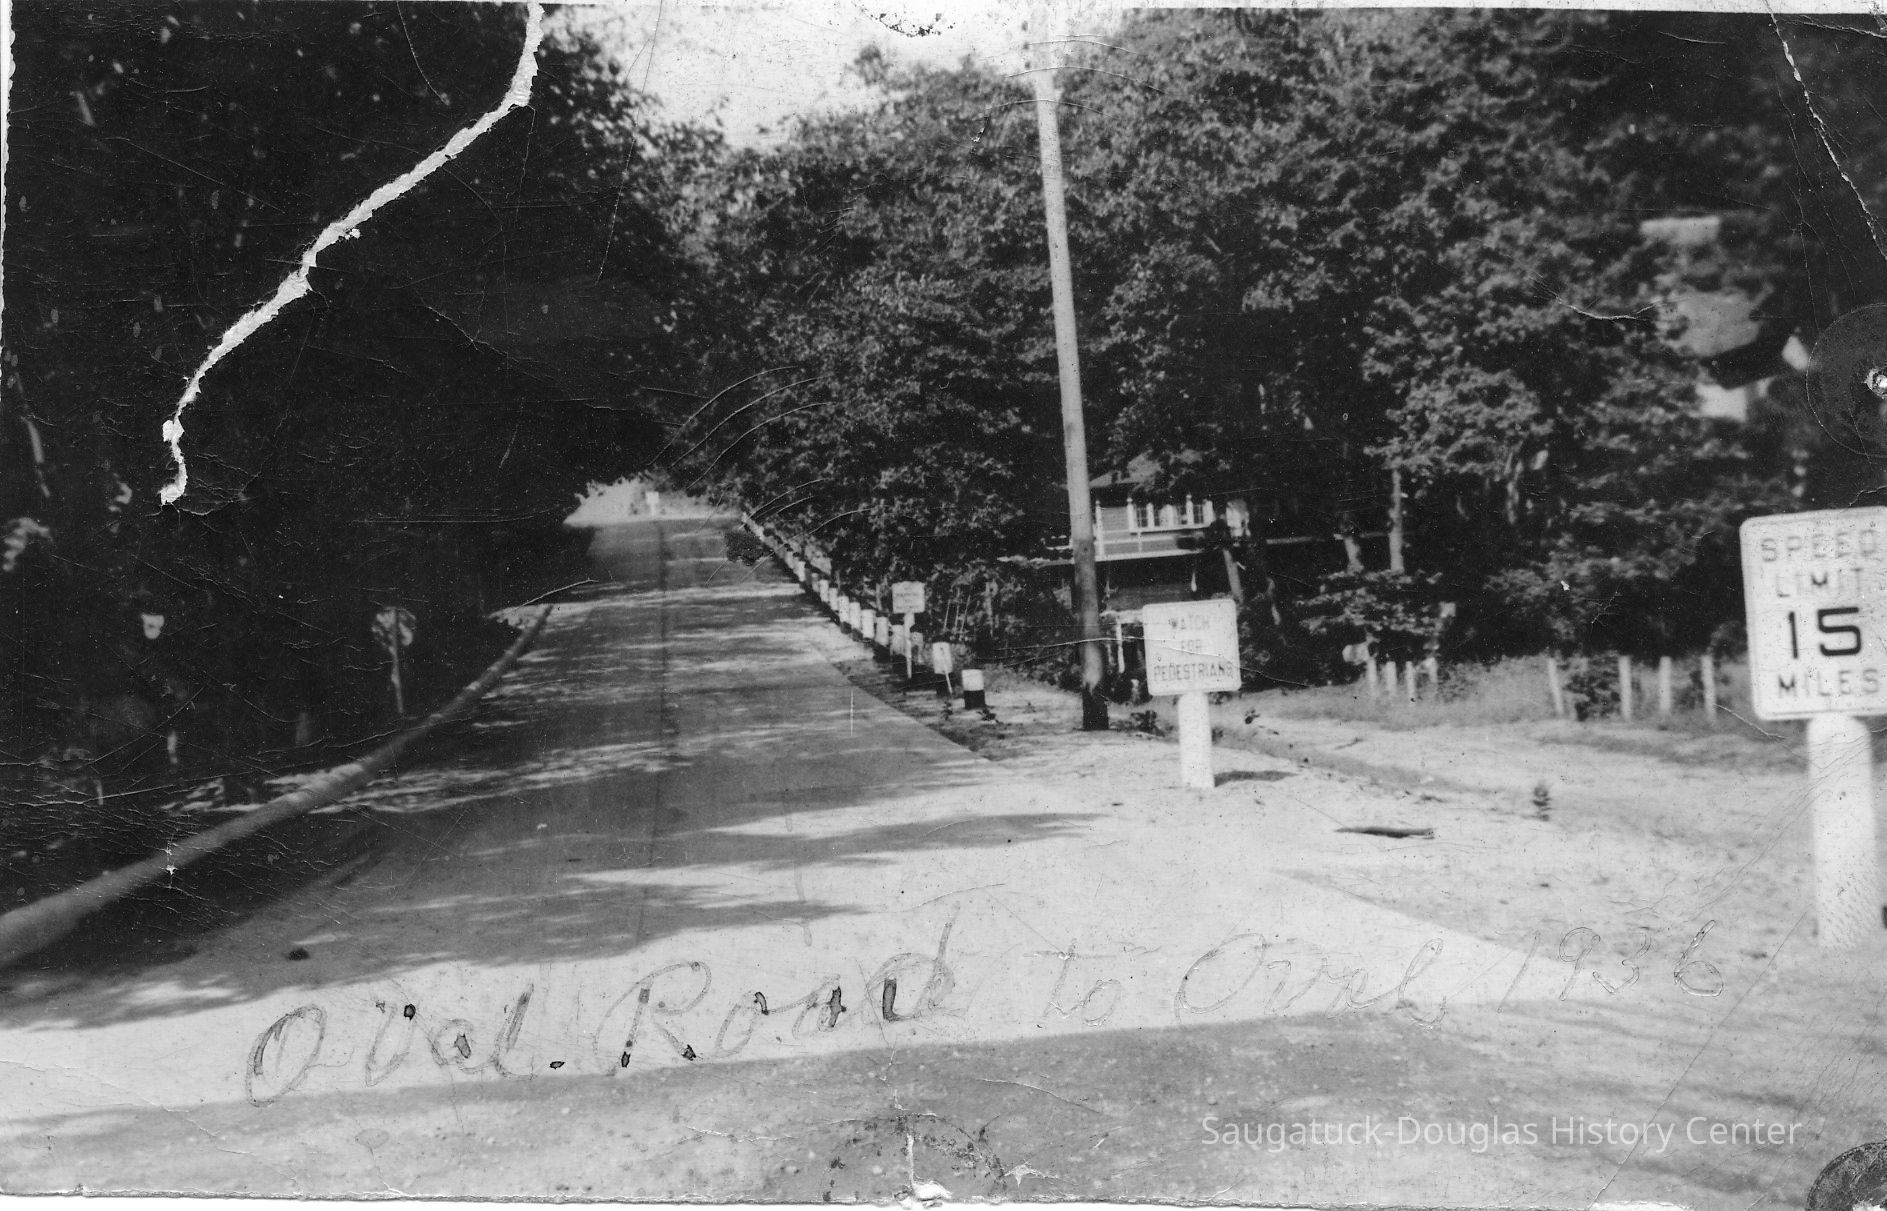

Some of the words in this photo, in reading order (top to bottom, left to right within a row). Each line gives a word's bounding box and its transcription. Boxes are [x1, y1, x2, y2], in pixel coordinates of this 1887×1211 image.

[1761, 528, 1877, 562] SPEED
[1775, 565, 1864, 598] LIMIT
[1168, 613, 1209, 631] WATCH
[1788, 606, 1862, 660] 15
[1153, 661, 1234, 681] PEDESTRIANS
[1778, 668, 1879, 699] MILES
[592, 904, 962, 1078] Road
[1024, 938, 1122, 1028] to
[1497, 919, 1724, 1014] 1936
